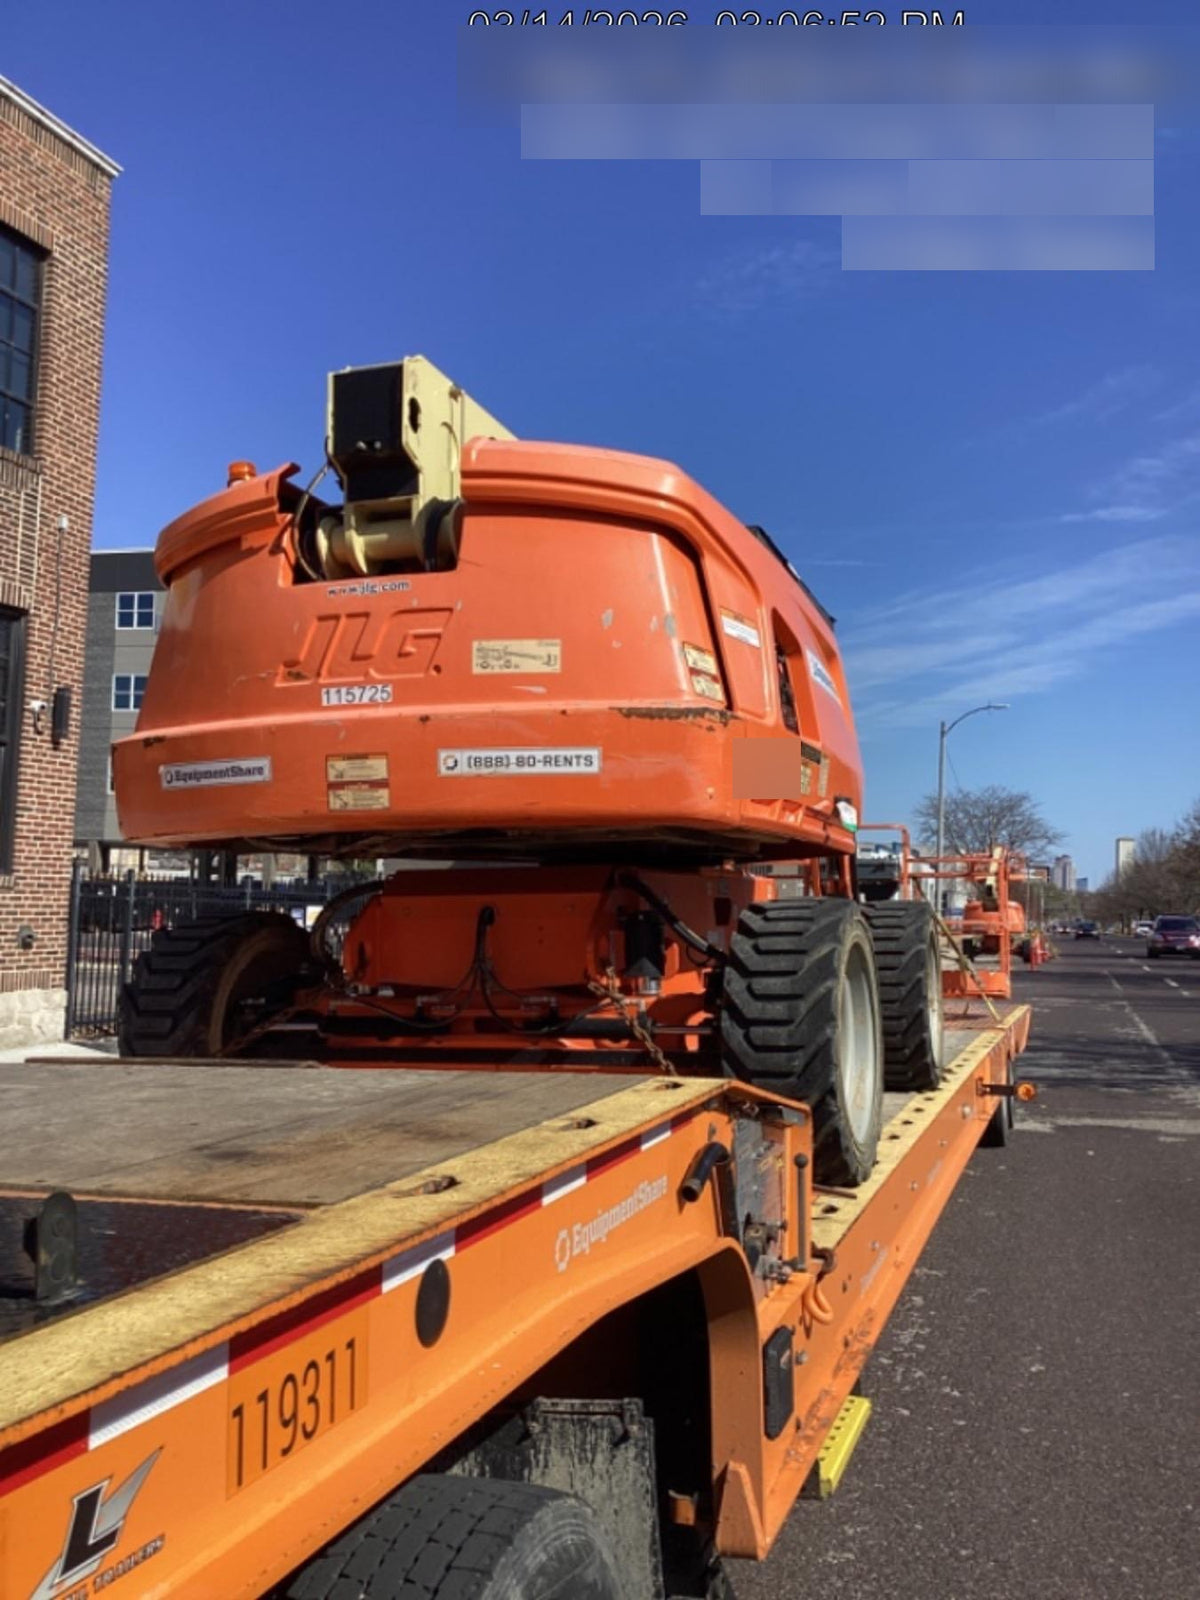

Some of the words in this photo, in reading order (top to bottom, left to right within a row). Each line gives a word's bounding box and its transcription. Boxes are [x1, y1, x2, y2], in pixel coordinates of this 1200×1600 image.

[274, 607, 454, 687] JLG
[323, 684, 391, 704] 115725
[174, 765, 265, 783] EquipmentShare
[466, 754, 511, 769] (888)
[572, 1174, 668, 1256] EquipmentShare
[231, 1337, 356, 1488] 119311
